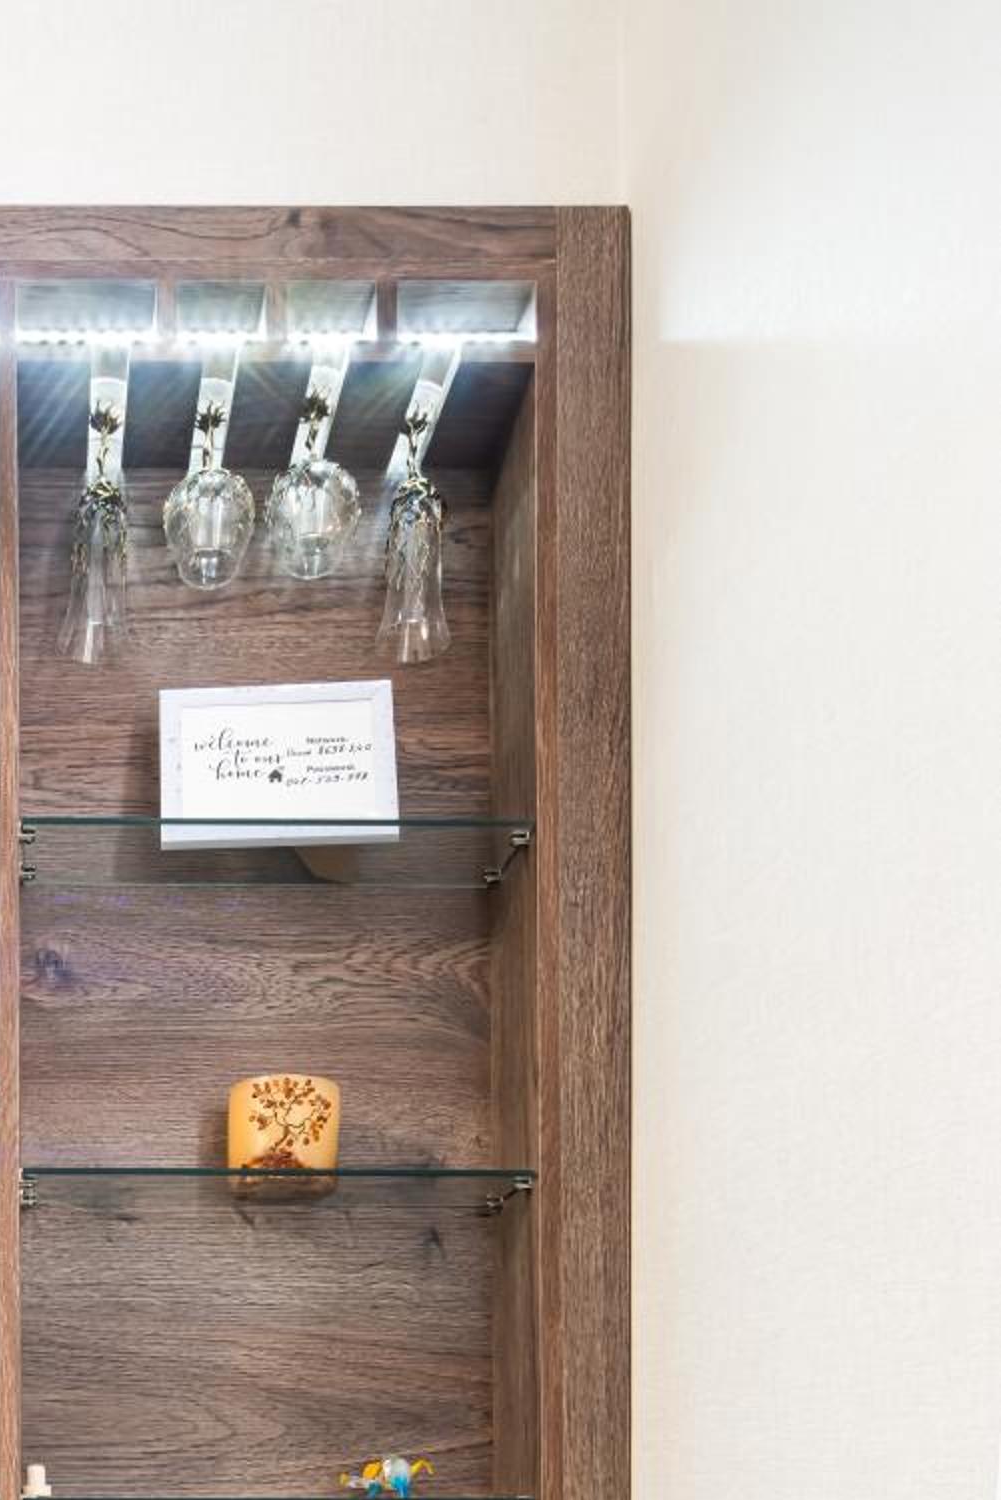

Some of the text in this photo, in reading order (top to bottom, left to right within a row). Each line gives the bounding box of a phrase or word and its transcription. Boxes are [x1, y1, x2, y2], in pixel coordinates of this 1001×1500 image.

[194, 728, 272, 751] welcome
[208, 757, 267, 780] home
[254, 753, 283, 764] our
